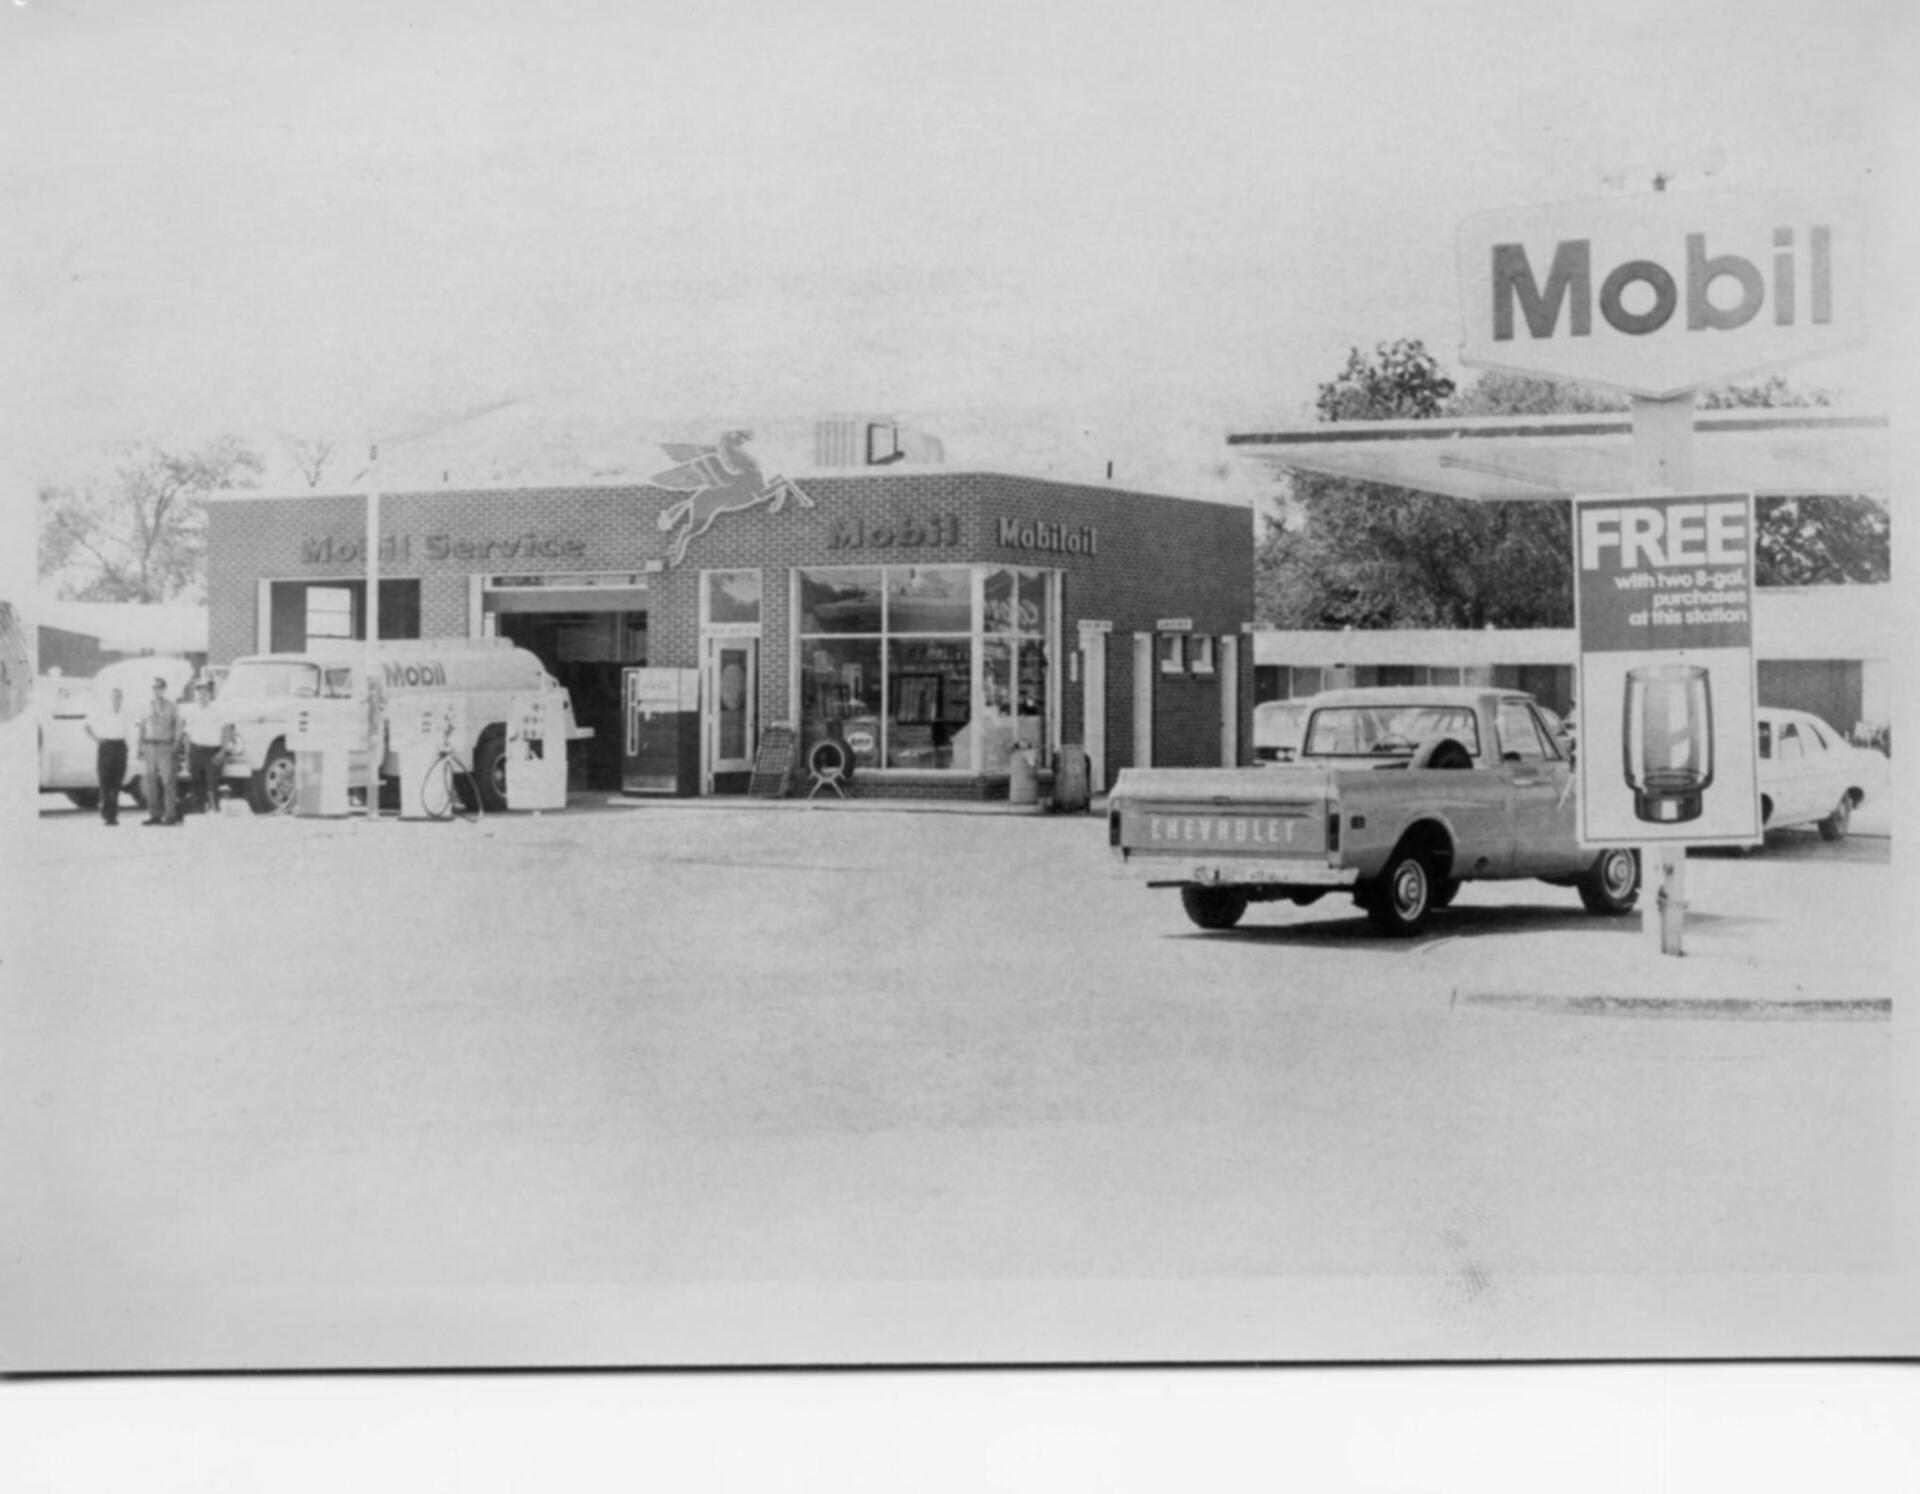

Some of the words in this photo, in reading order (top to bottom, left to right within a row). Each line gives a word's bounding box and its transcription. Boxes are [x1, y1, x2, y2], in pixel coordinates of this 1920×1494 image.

[1492, 225, 1832, 342] Mobil
[828, 512, 958, 549] Mobil
[998, 514, 1098, 554] Mobiloil
[1581, 502, 1747, 571] FREE
[425, 532, 587, 561] Service
[1614, 572, 1655, 589] with
[1656, 573, 1693, 588] two
[1653, 589, 1746, 608] purchases
[1628, 610, 1648, 627] at
[1652, 609, 1683, 626] this
[1685, 608, 1747, 624] station
[382, 660, 447, 688] Mobil
[1151, 818, 1295, 842] CHEVROLET
